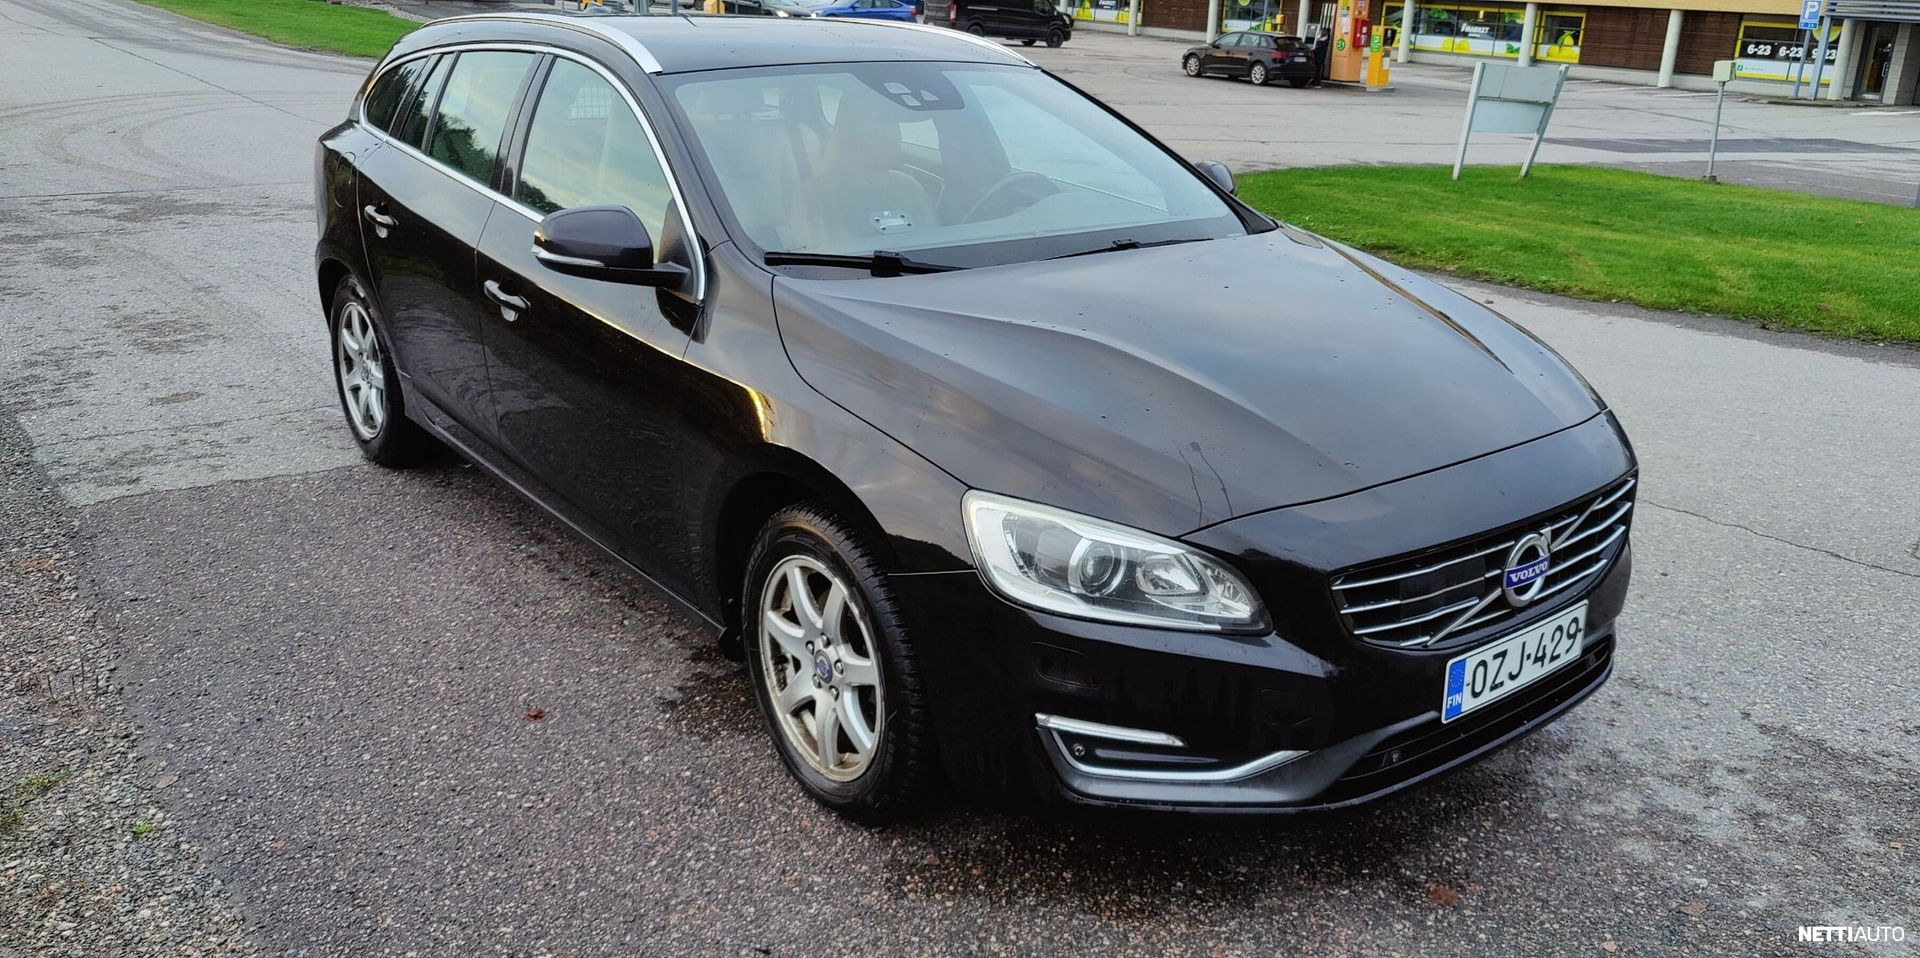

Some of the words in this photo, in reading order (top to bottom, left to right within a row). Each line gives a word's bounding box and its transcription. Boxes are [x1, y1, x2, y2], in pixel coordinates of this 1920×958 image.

[1805, 1, 1819, 19] P
[1747, 44, 1772, 56] 6-23
[1779, 46, 1803, 58] 6-23
[1811, 48, 1837, 60] 923
[1509, 562, 1548, 583] VOLVO
[1470, 616, 1580, 698] OZJ-429
[1446, 692, 1462, 709] FIN
